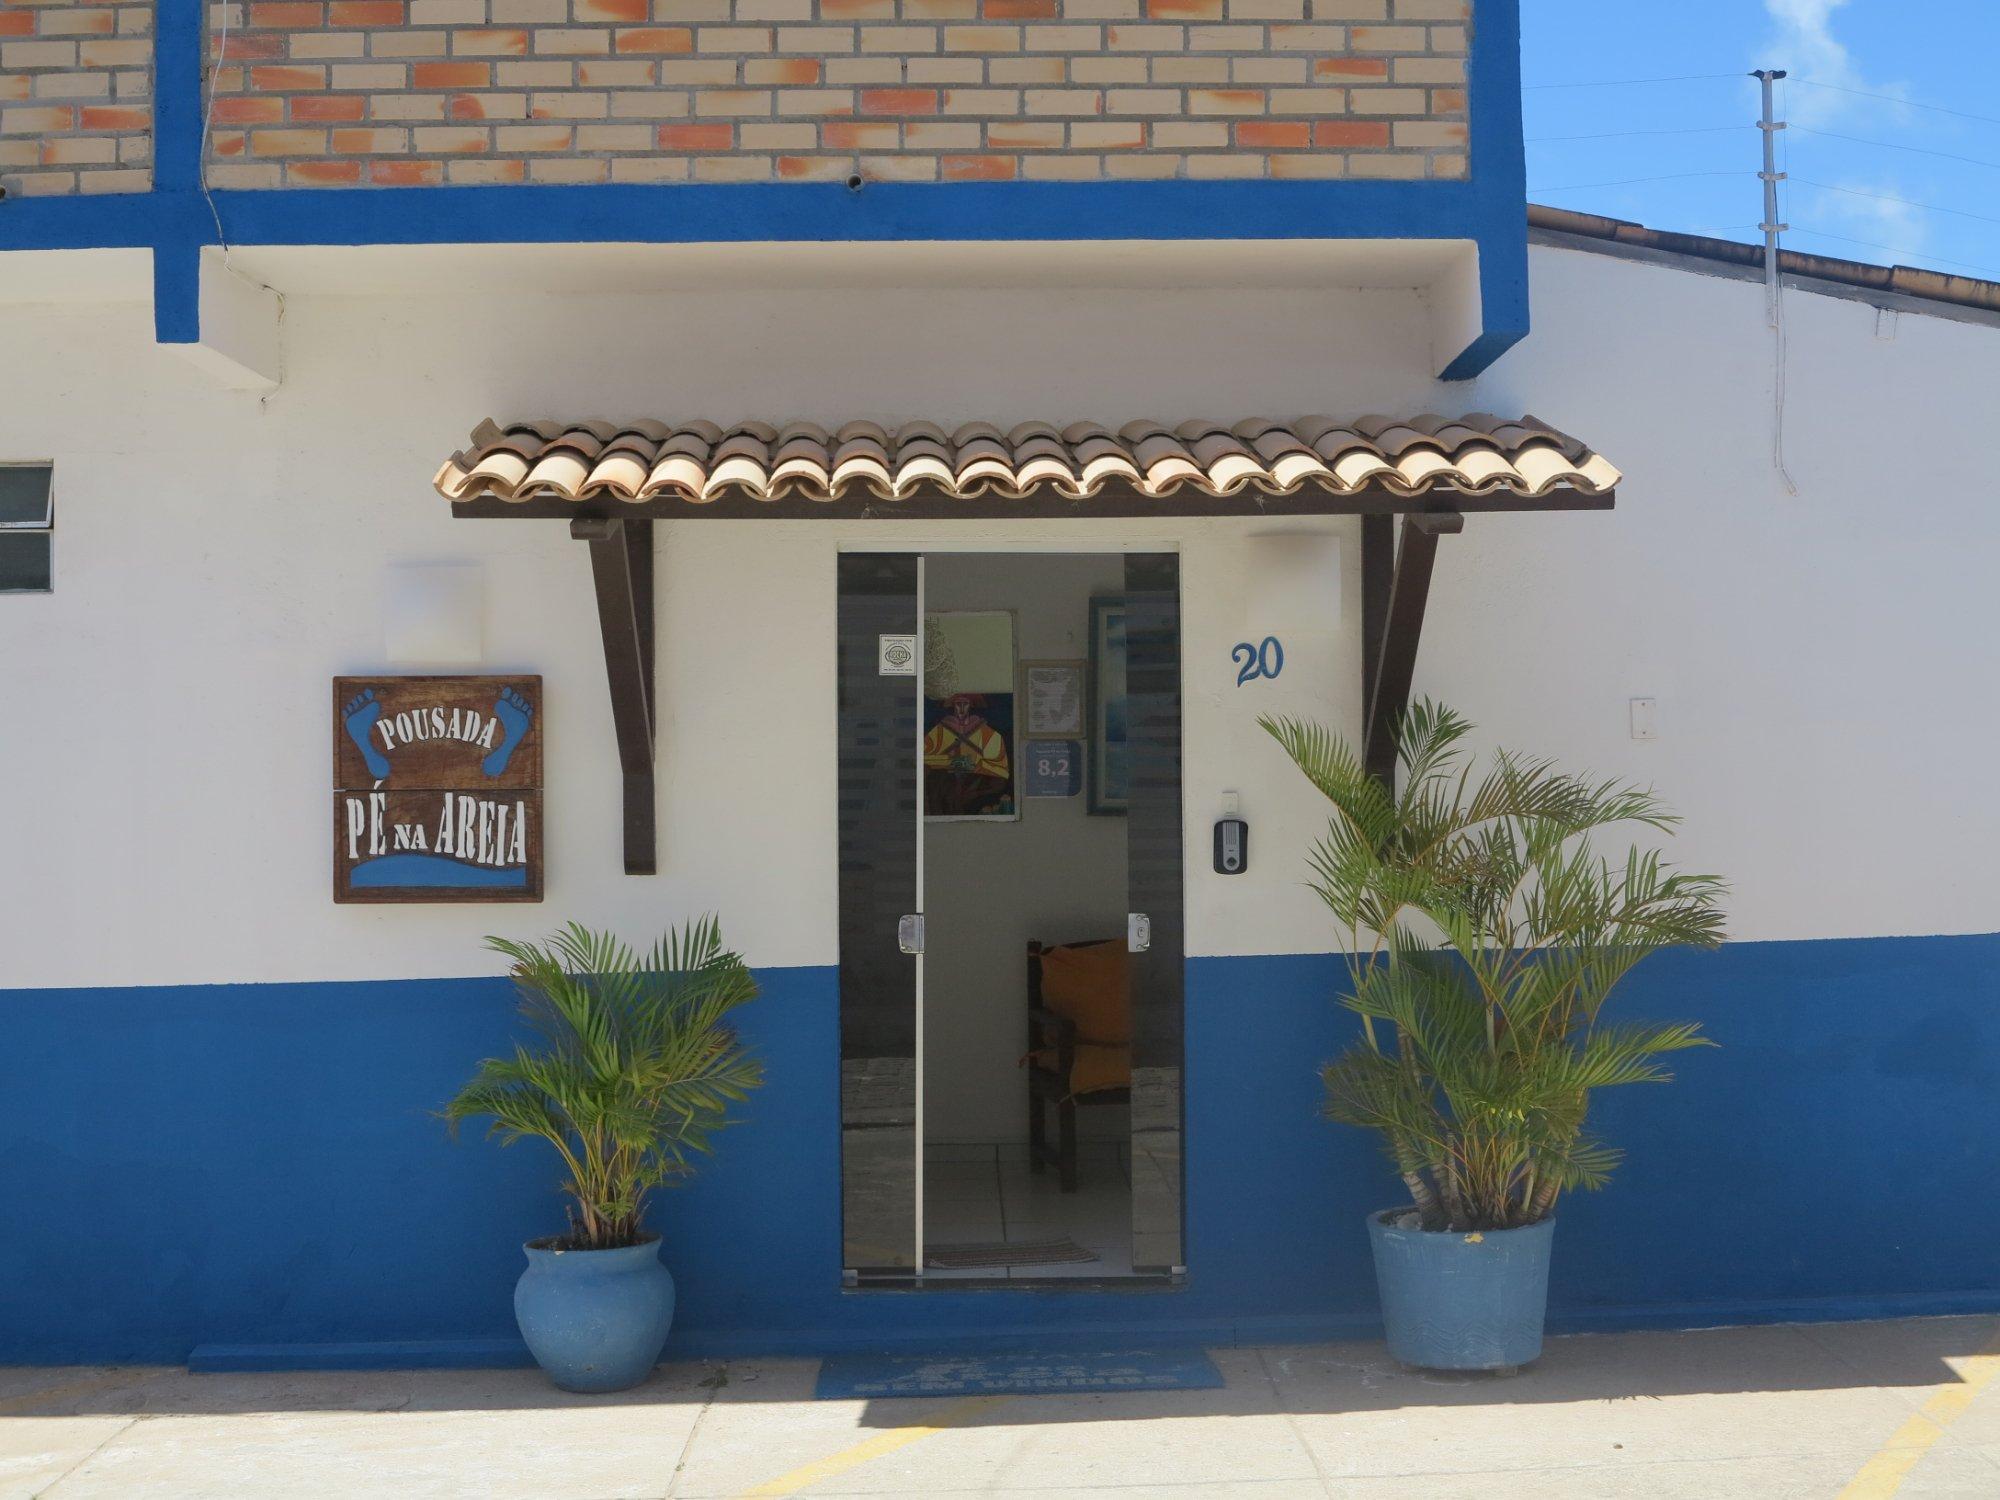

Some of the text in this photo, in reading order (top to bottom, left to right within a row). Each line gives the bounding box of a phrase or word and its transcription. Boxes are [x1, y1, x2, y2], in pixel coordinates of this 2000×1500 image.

[1231, 636, 1284, 688] 20
[376, 706, 498, 750] POUSADA
[1038, 758, 1070, 778] 8,2
[346, 779, 527, 867] PÉ NA AREIA
